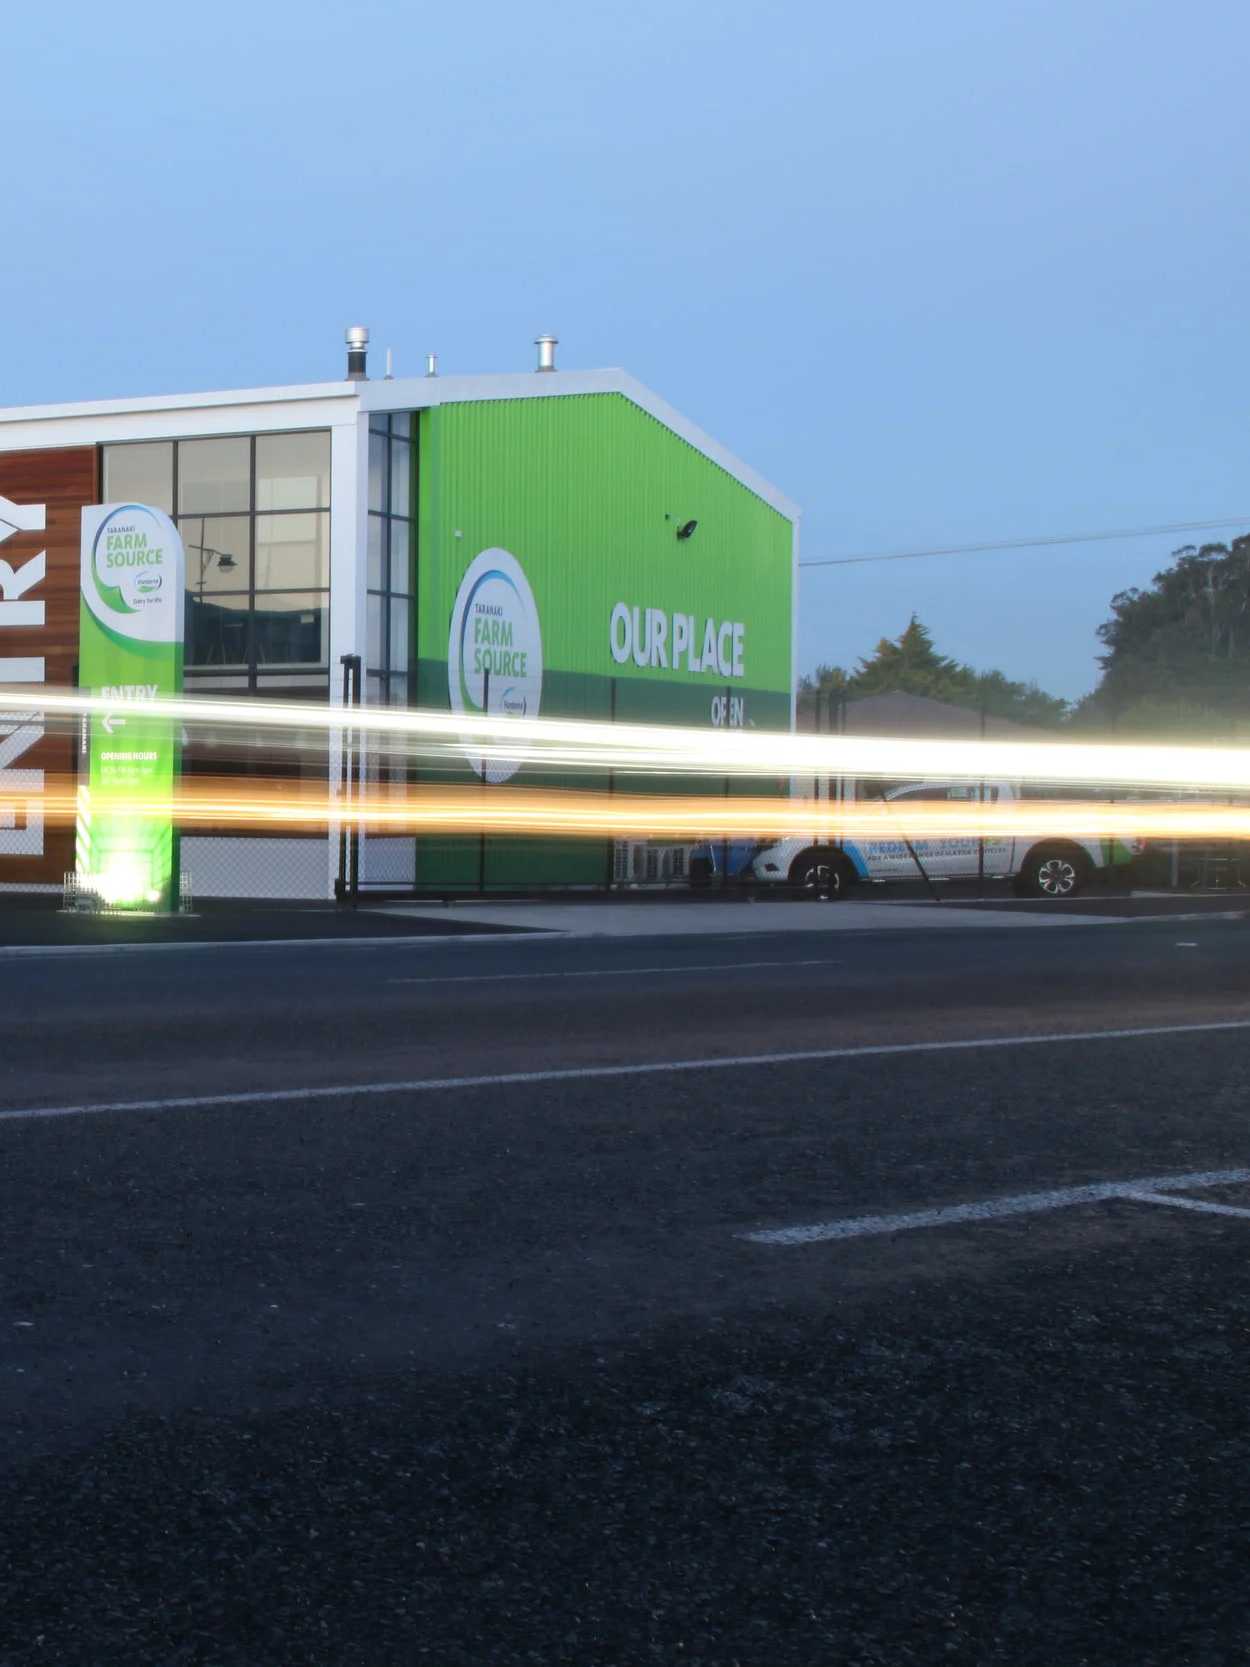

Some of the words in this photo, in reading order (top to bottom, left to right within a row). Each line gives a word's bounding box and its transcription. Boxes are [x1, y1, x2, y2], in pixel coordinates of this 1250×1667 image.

[107, 525, 136, 534] TARANAKI
[106, 533, 147, 551] FARM
[106, 548, 163, 569] SOURCE
[475, 603, 503, 617] TARANAKI
[474, 618, 513, 648] FARM
[610, 601, 668, 668] OUR
[672, 612, 744, 677] PLACE
[474, 649, 527, 678] SOURCE
[101, 684, 159, 704] ENTRY
[711, 696, 744, 728] OPEN
[101, 751, 132, 760] OPENING
[132, 751, 158, 761] HOURS
